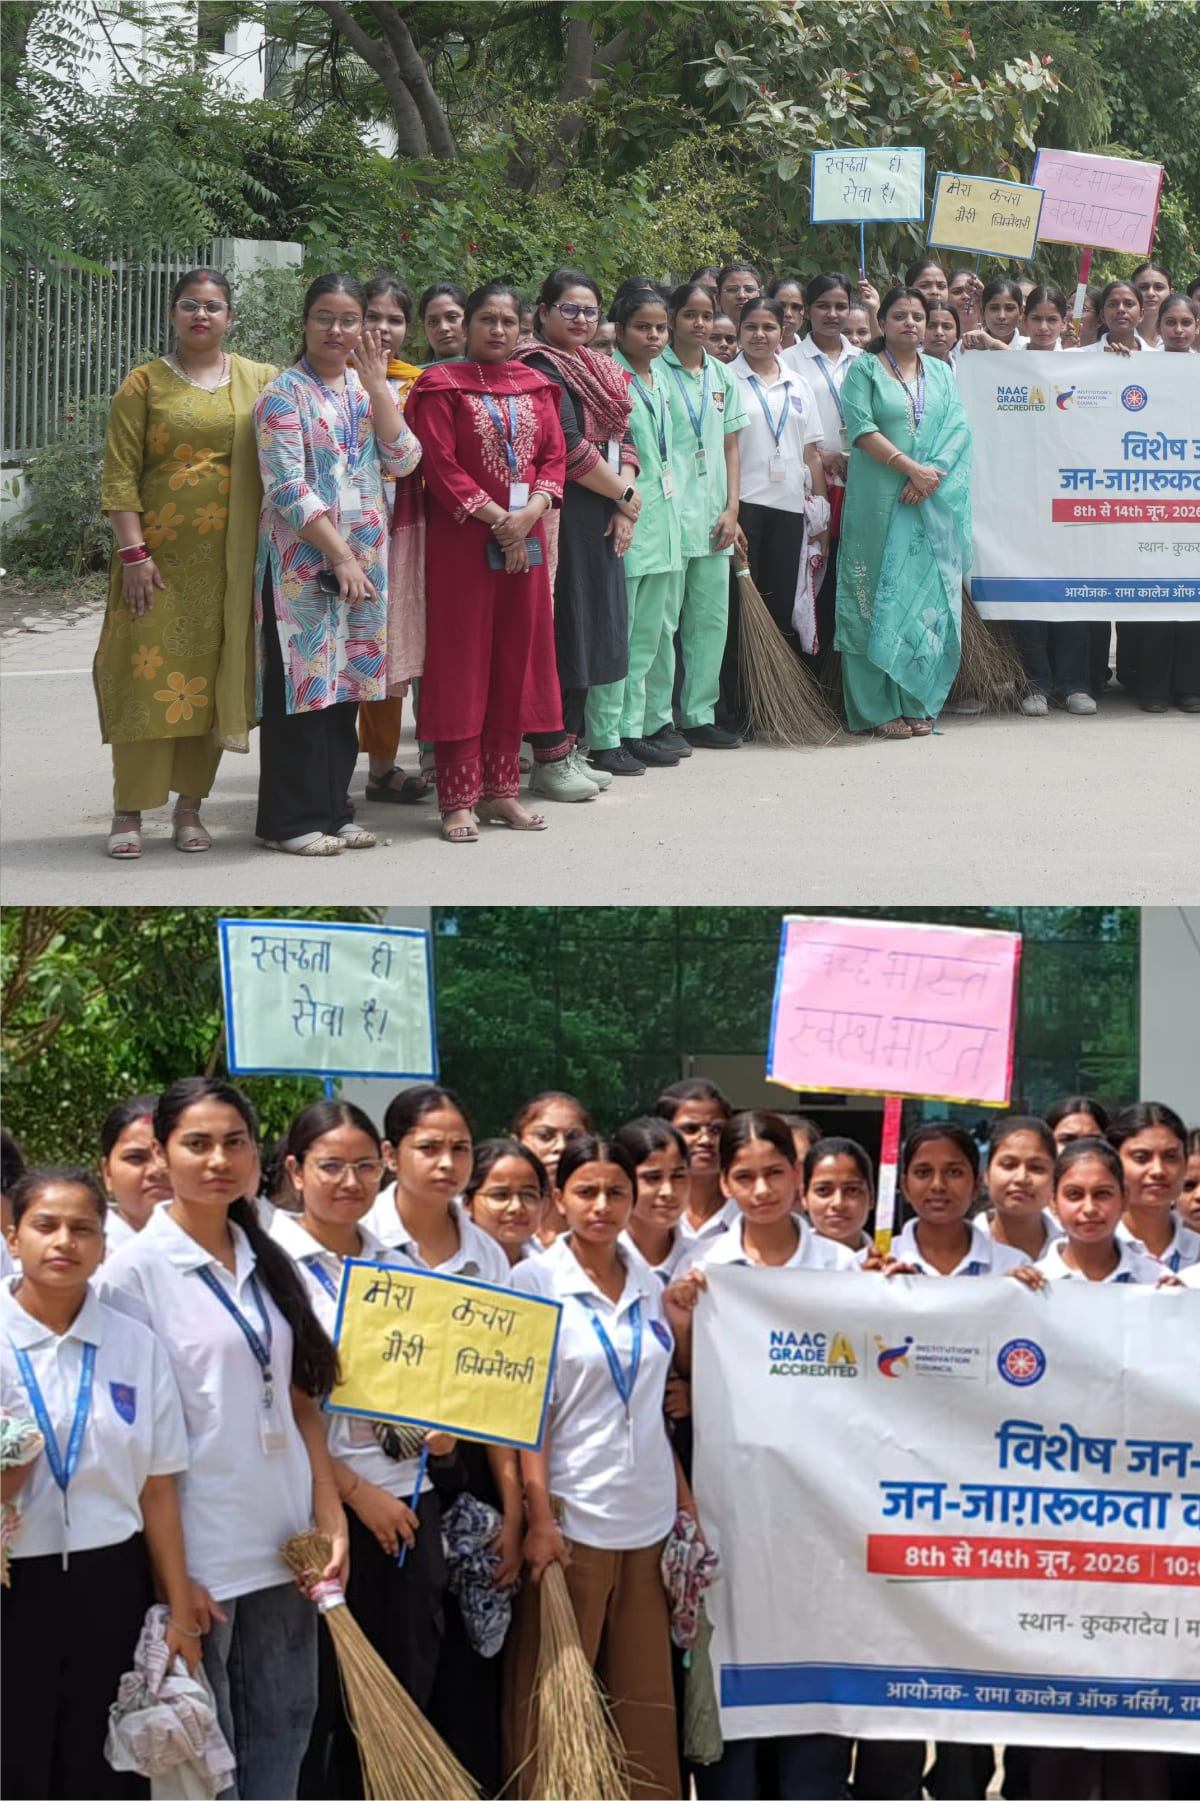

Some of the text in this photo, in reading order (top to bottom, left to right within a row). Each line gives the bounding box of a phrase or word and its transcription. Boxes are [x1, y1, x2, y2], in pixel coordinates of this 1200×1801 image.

[889, 154, 904, 173] ही
[843, 177, 872, 204] सेवा
[997, 386, 1028, 395] NAAC
[997, 395, 1028, 404] GRADE
[996, 404, 1046, 412] ACCREDITED
[1121, 431, 1188, 461] विशेष
[1073, 505, 1097, 518] 8th
[1099, 502, 1111, 518] से
[1114, 505, 1143, 518] 14th
[1146, 505, 1169, 522] जून,
[1137, 541, 1169, 554] स्थान-
[1114, 587, 1135, 598] रामा
[1137, 585, 1170, 598] कालेज
[1172, 584, 1195, 598] ऑफ
[370, 941, 394, 979] ही
[291, 983, 345, 1037] सेवा
[363, 1267, 521, 1336] मेरा कचरा
[769, 1330, 828, 1346] NAAC
[769, 1347, 826, 1363] GRADE
[769, 1363, 858, 1378] ACCREDITED
[995, 1419, 1117, 1473] विशेष
[905, 1546, 946, 1568] 8th
[951, 1541, 972, 1567] से
[978, 1548, 1030, 1569] 14th
[1036, 1549, 1076, 1577] जून,
[1083, 1553, 1141, 1575] 2026
[1018, 1612, 1074, 1632] स्थान-
[1080, 1611, 1169, 1640] कुकरादेव
[974, 1685, 1010, 1704] रामा
[1015, 1685, 1073, 1708] कालेज
[1077, 1688, 1117, 1709] ऑफ
